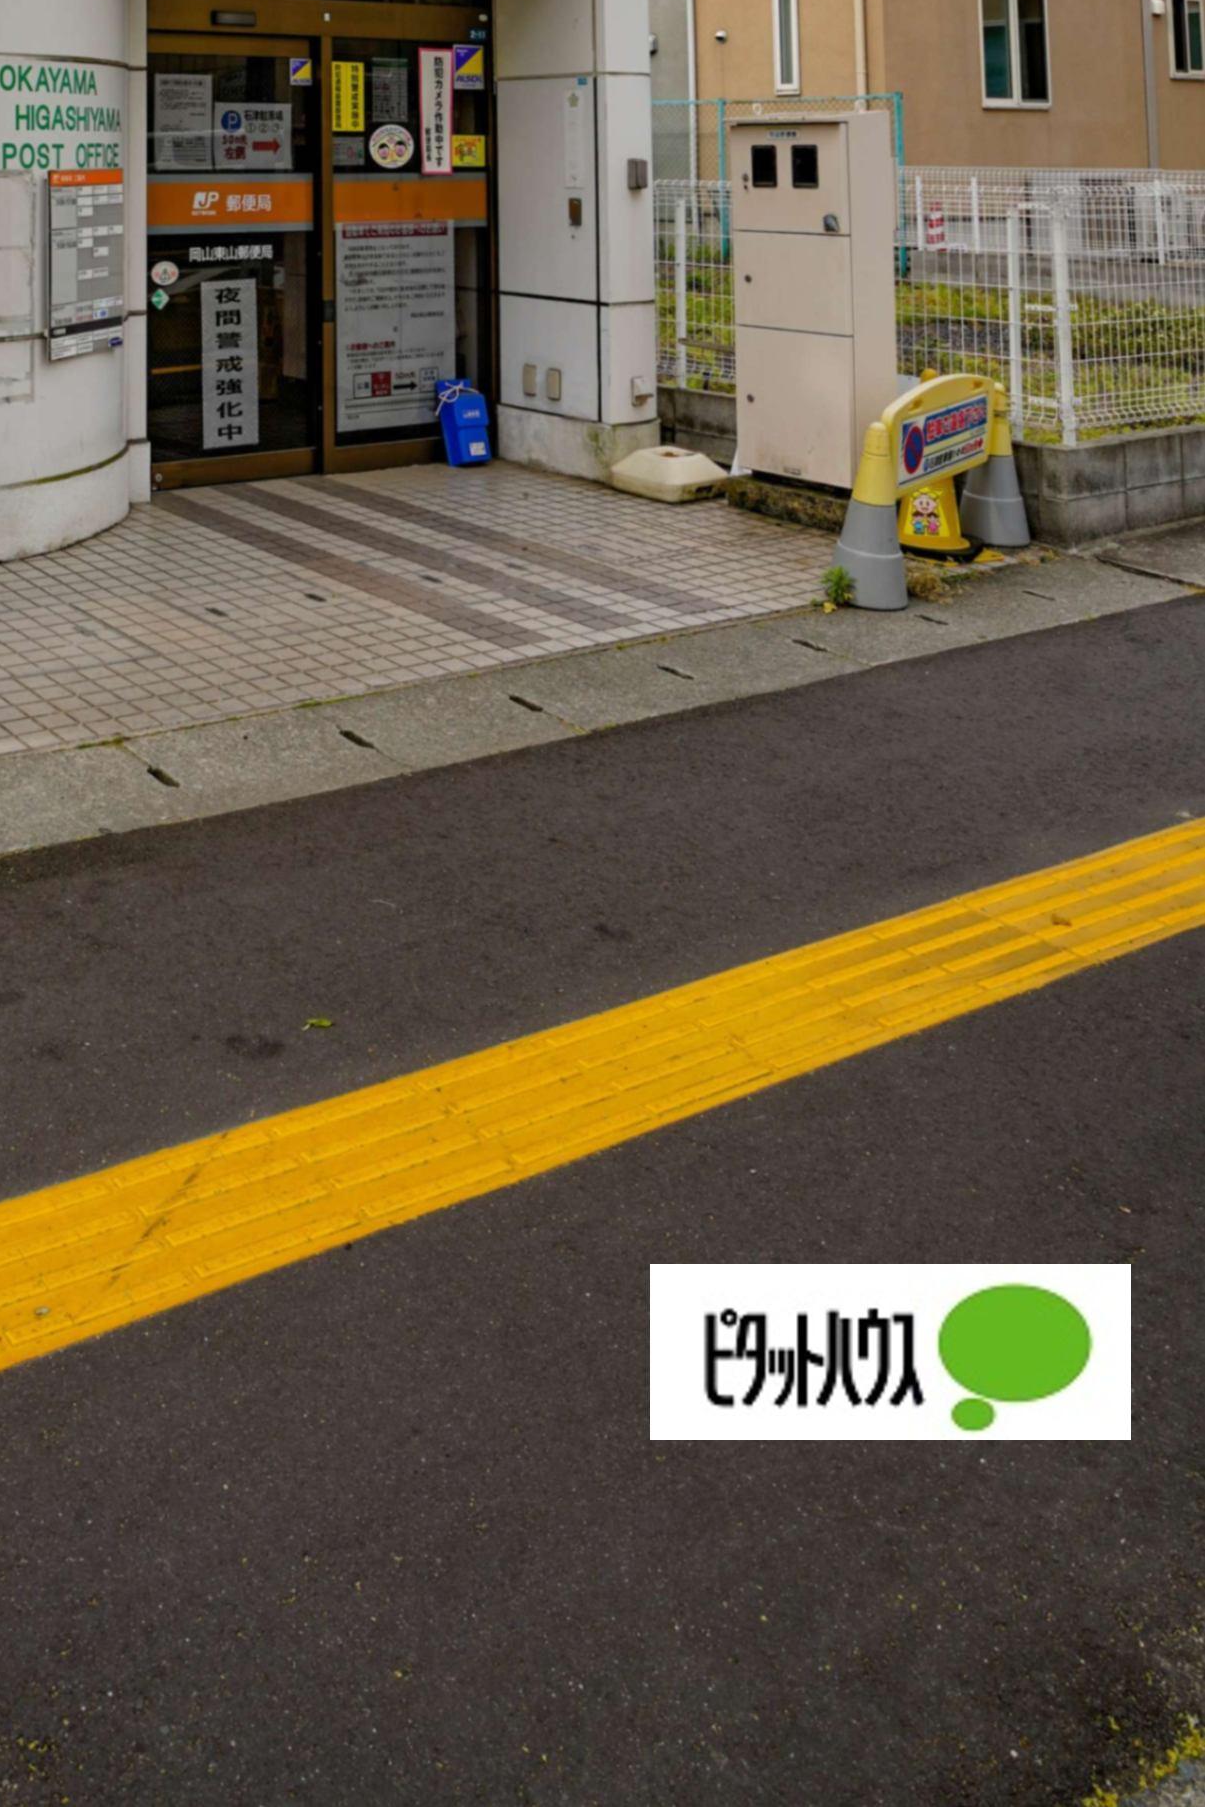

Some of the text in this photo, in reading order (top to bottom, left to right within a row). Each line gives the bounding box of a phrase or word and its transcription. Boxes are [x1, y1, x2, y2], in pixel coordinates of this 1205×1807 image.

[0, 64, 97, 96] OKAYAMA
[15, 104, 121, 132] HIGASHIYAMA
[2, 142, 119, 170] POST OFFICE
[193, 191, 220, 210] JP
[226, 193, 272, 213] 郵便局
[189, 244, 273, 263] 岡山東山郵便局
[214, 286, 243, 441] 夜間警戒強化中
